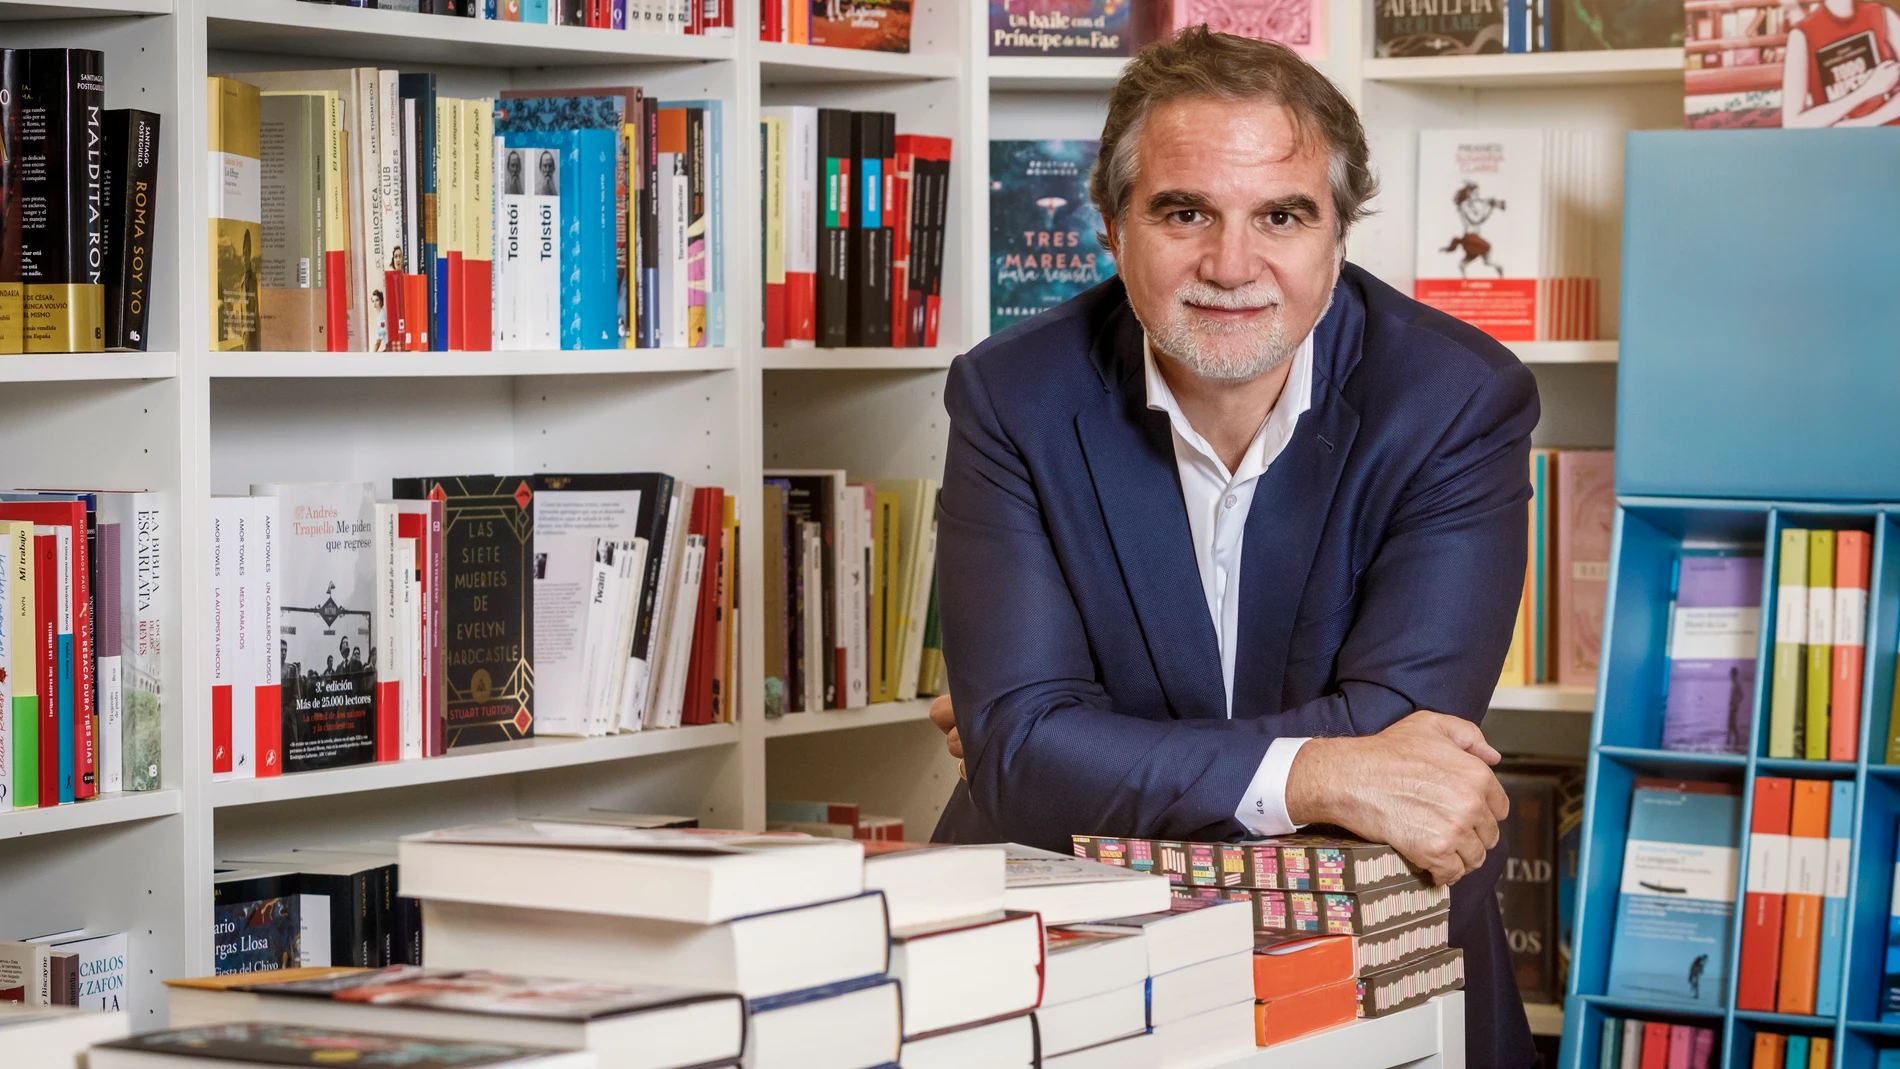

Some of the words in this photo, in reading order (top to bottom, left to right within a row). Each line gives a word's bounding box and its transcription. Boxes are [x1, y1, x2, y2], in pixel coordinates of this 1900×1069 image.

[1010, 14, 1027, 27] Un
[1029, 10, 1070, 29] baile
[994, 28, 1062, 51] Príncipe
[1091, 31, 1120, 48] Fae
[452, 147, 456, 158] de
[474, 139, 479, 150] de
[88, 106, 100, 224] MALDITA
[332, 162, 338, 171] El
[383, 166, 391, 195] CLUB
[134, 182, 147, 238] ROMA
[395, 229, 400, 238] DE
[508, 204, 518, 261] Tolstói
[540, 205, 551, 261] Tolstói
[1024, 231, 1079, 247] TRES
[132, 246, 144, 284] SOY
[1005, 253, 1096, 268] MAREAS
[998, 266, 1039, 285] para
[131, 290, 142, 314] YO
[305, 505, 338, 519] Andrés
[152, 510, 159, 531] LA
[293, 521, 334, 537] Trapiello
[336, 520, 349, 533] Me
[352, 519, 371, 535] piden
[469, 522, 493, 538] LAS
[326, 540, 341, 552] que
[344, 539, 371, 551] regrese
[138, 510, 150, 611] ESCARLATA
[462, 546, 500, 564] SIETE
[19, 567, 26, 581] Mi
[389, 567, 394, 577] de
[454, 570, 507, 589] MUERTES
[215, 588, 220, 597] LA
[266, 582, 271, 593] UN
[594, 571, 605, 604] Twain
[474, 595, 488, 611] DE
[389, 608, 394, 618] La
[82, 625, 87, 638] LA
[150, 620, 154, 631] DE
[456, 621, 505, 640] EVELYN
[267, 643, 271, 653] EN
[442, 645, 518, 667] HARDCASTLE
[326, 679, 353, 692] edición
[296, 698, 311, 710] Más
[312, 698, 320, 708] de
[322, 696, 344, 708] 25.000
[345, 695, 371, 705] lectores
[450, 707, 479, 720] STUART
[482, 704, 514, 718] TURTON
[241, 935, 268, 951] Llosa
[79, 955, 123, 977] CARLOS
[240, 962, 251, 974] del
[254, 960, 278, 972] Chivo
[87, 972, 123, 995] ZAFÓN
[101, 994, 120, 1012] LA
